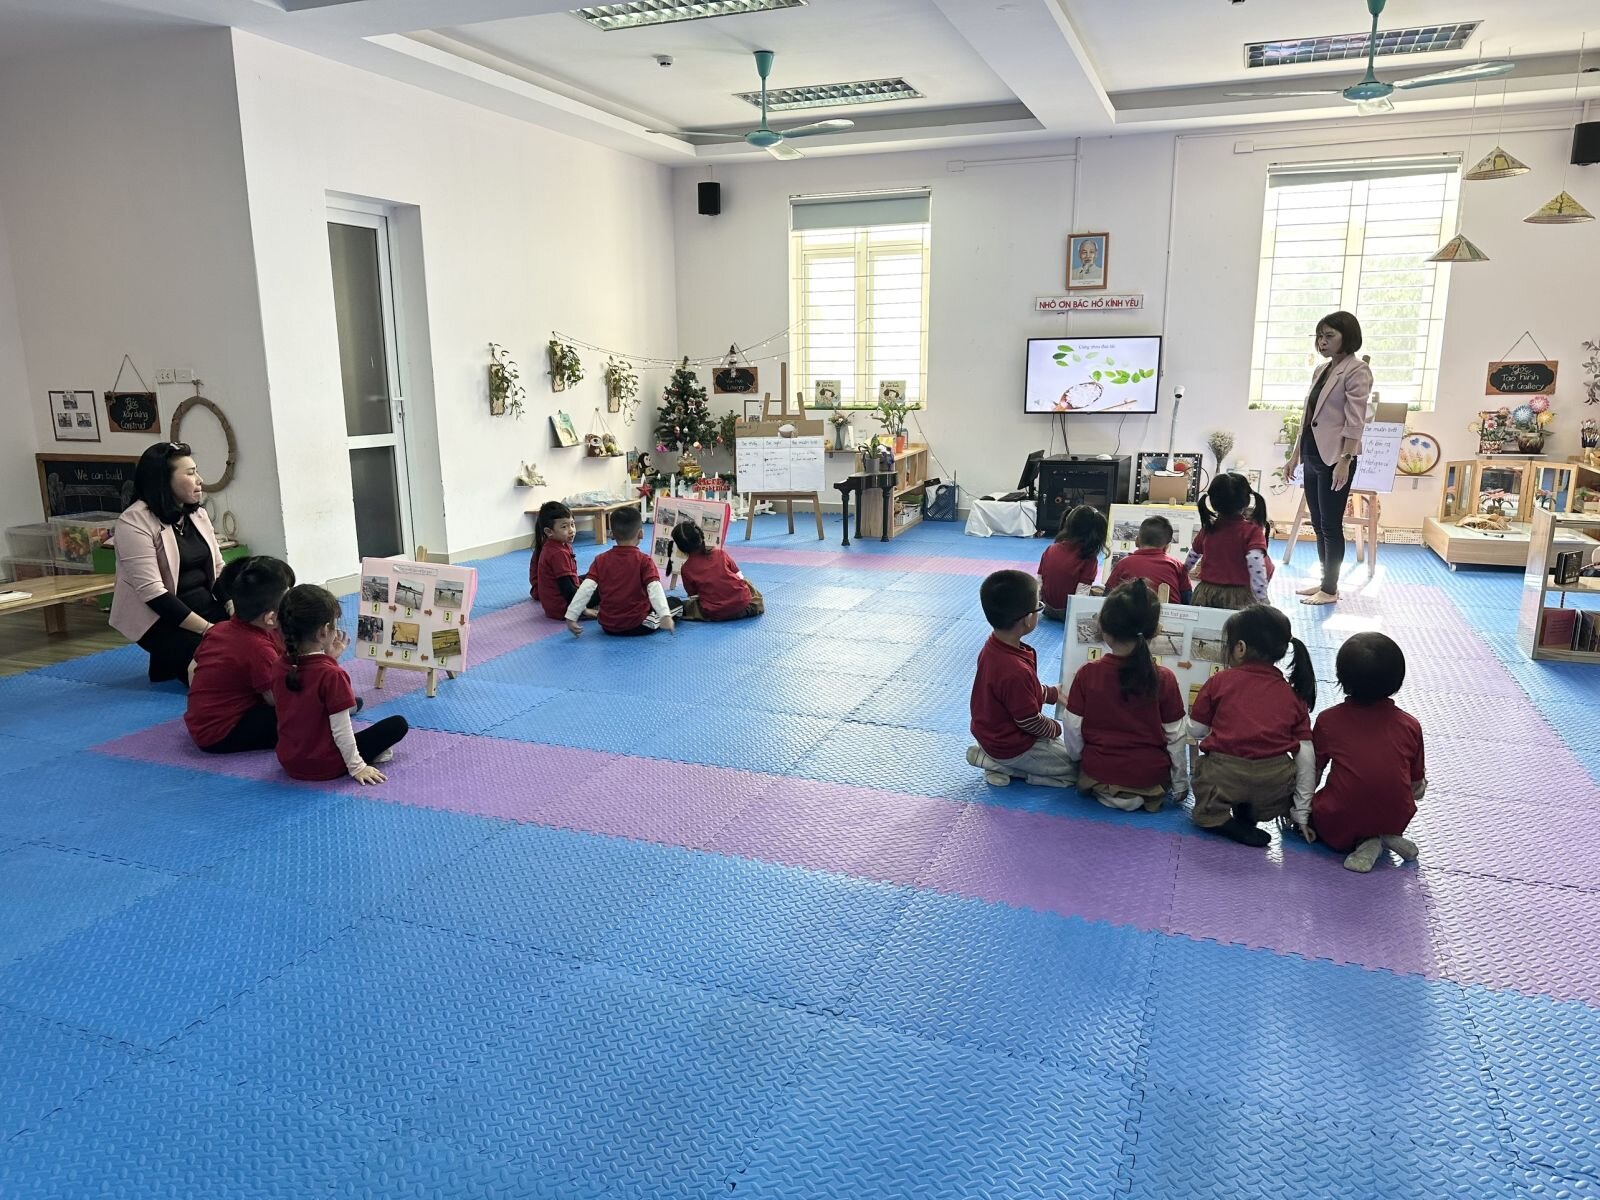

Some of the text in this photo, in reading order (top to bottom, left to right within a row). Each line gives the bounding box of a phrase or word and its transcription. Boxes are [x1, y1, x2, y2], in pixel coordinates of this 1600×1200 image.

[1073, 298, 1089, 308] BÁC
[1105, 297, 1123, 308] KÍNH
[1125, 297, 1139, 307] YÊU
[1500, 382, 1545, 391] Art Gallery
[74, 467, 123, 480] We can build
